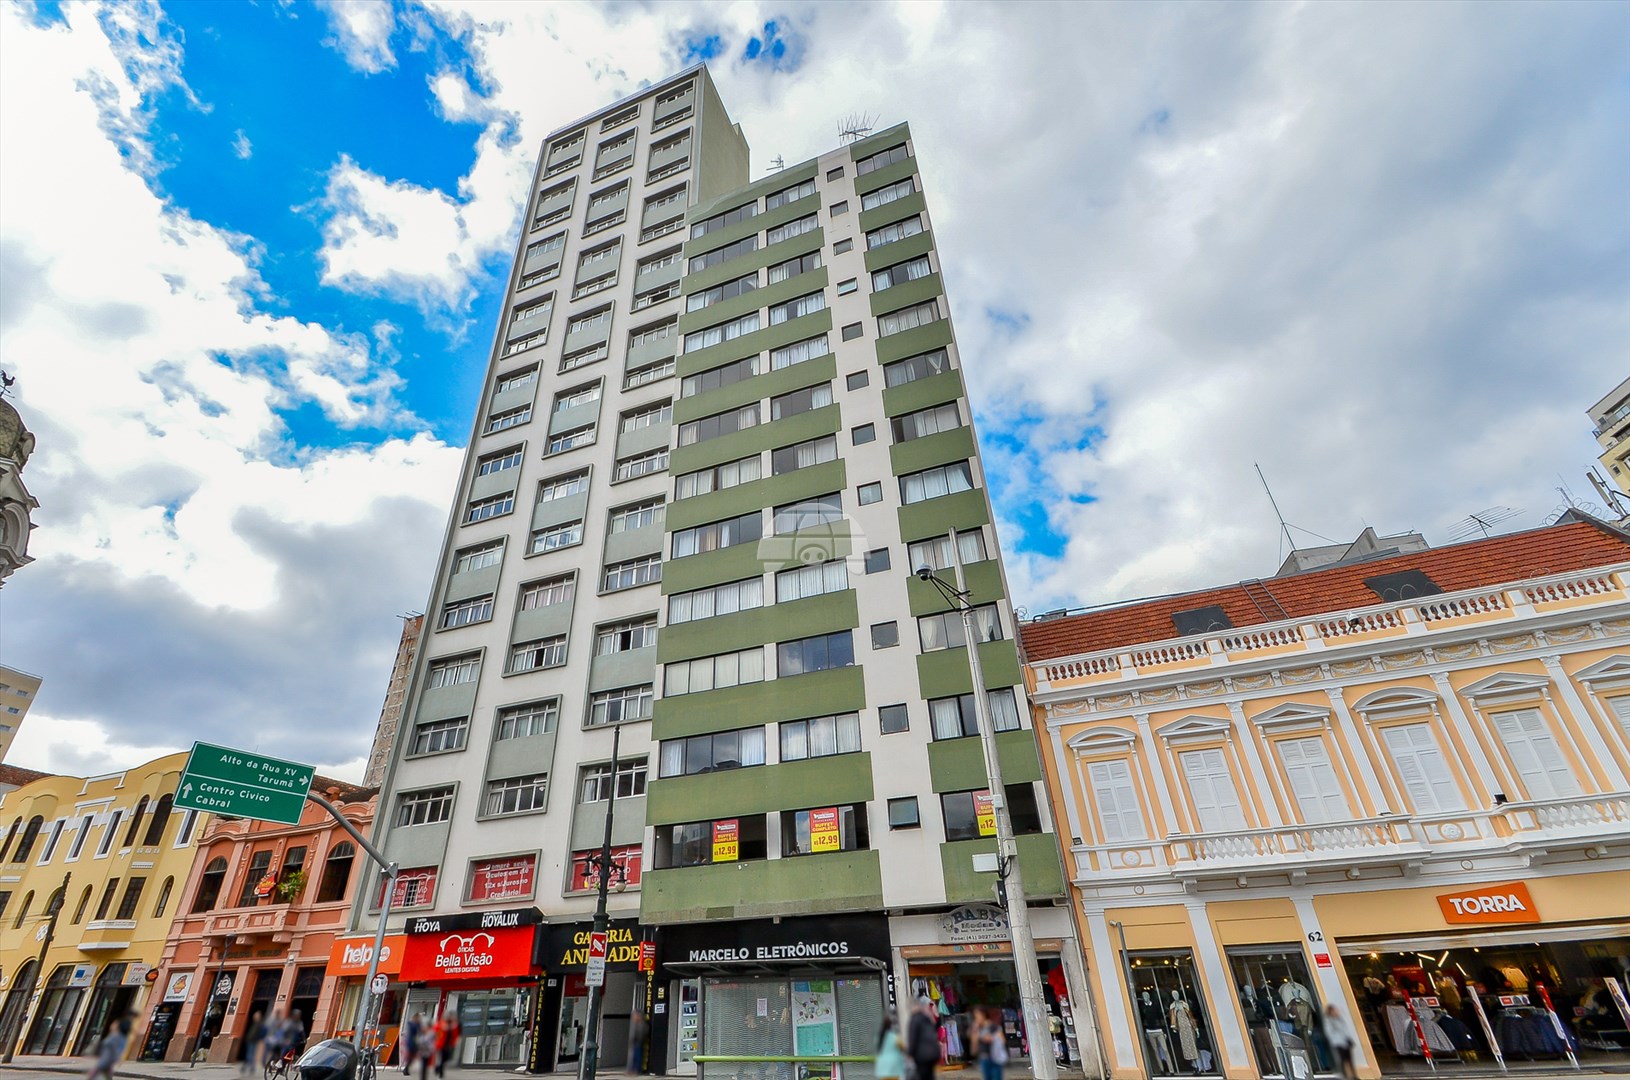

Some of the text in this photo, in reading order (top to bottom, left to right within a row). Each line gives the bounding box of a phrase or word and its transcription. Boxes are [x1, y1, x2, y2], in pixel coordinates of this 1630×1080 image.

[220, 754, 297, 777] Alto da Rua XV
[258, 774, 293, 788] Tarumã
[200, 783, 235, 796] Centro
[195, 795, 231, 808] Cabral
[818, 835, 838, 845] 12,99
[718, 845, 737, 856] 12,99
[1449, 894, 1526, 915] TORRA
[481, 912, 519, 928] HOYALUX
[952, 909, 1001, 924] BABY
[415, 921, 440, 933] HOYA
[573, 928, 633, 945] GARIA
[1307, 931, 1323, 942] 62
[561, 946, 641, 965] ANADE
[689, 941, 849, 962] MARCELO ELETRÔNICOS
[435, 952, 493, 967] Bella Visão
